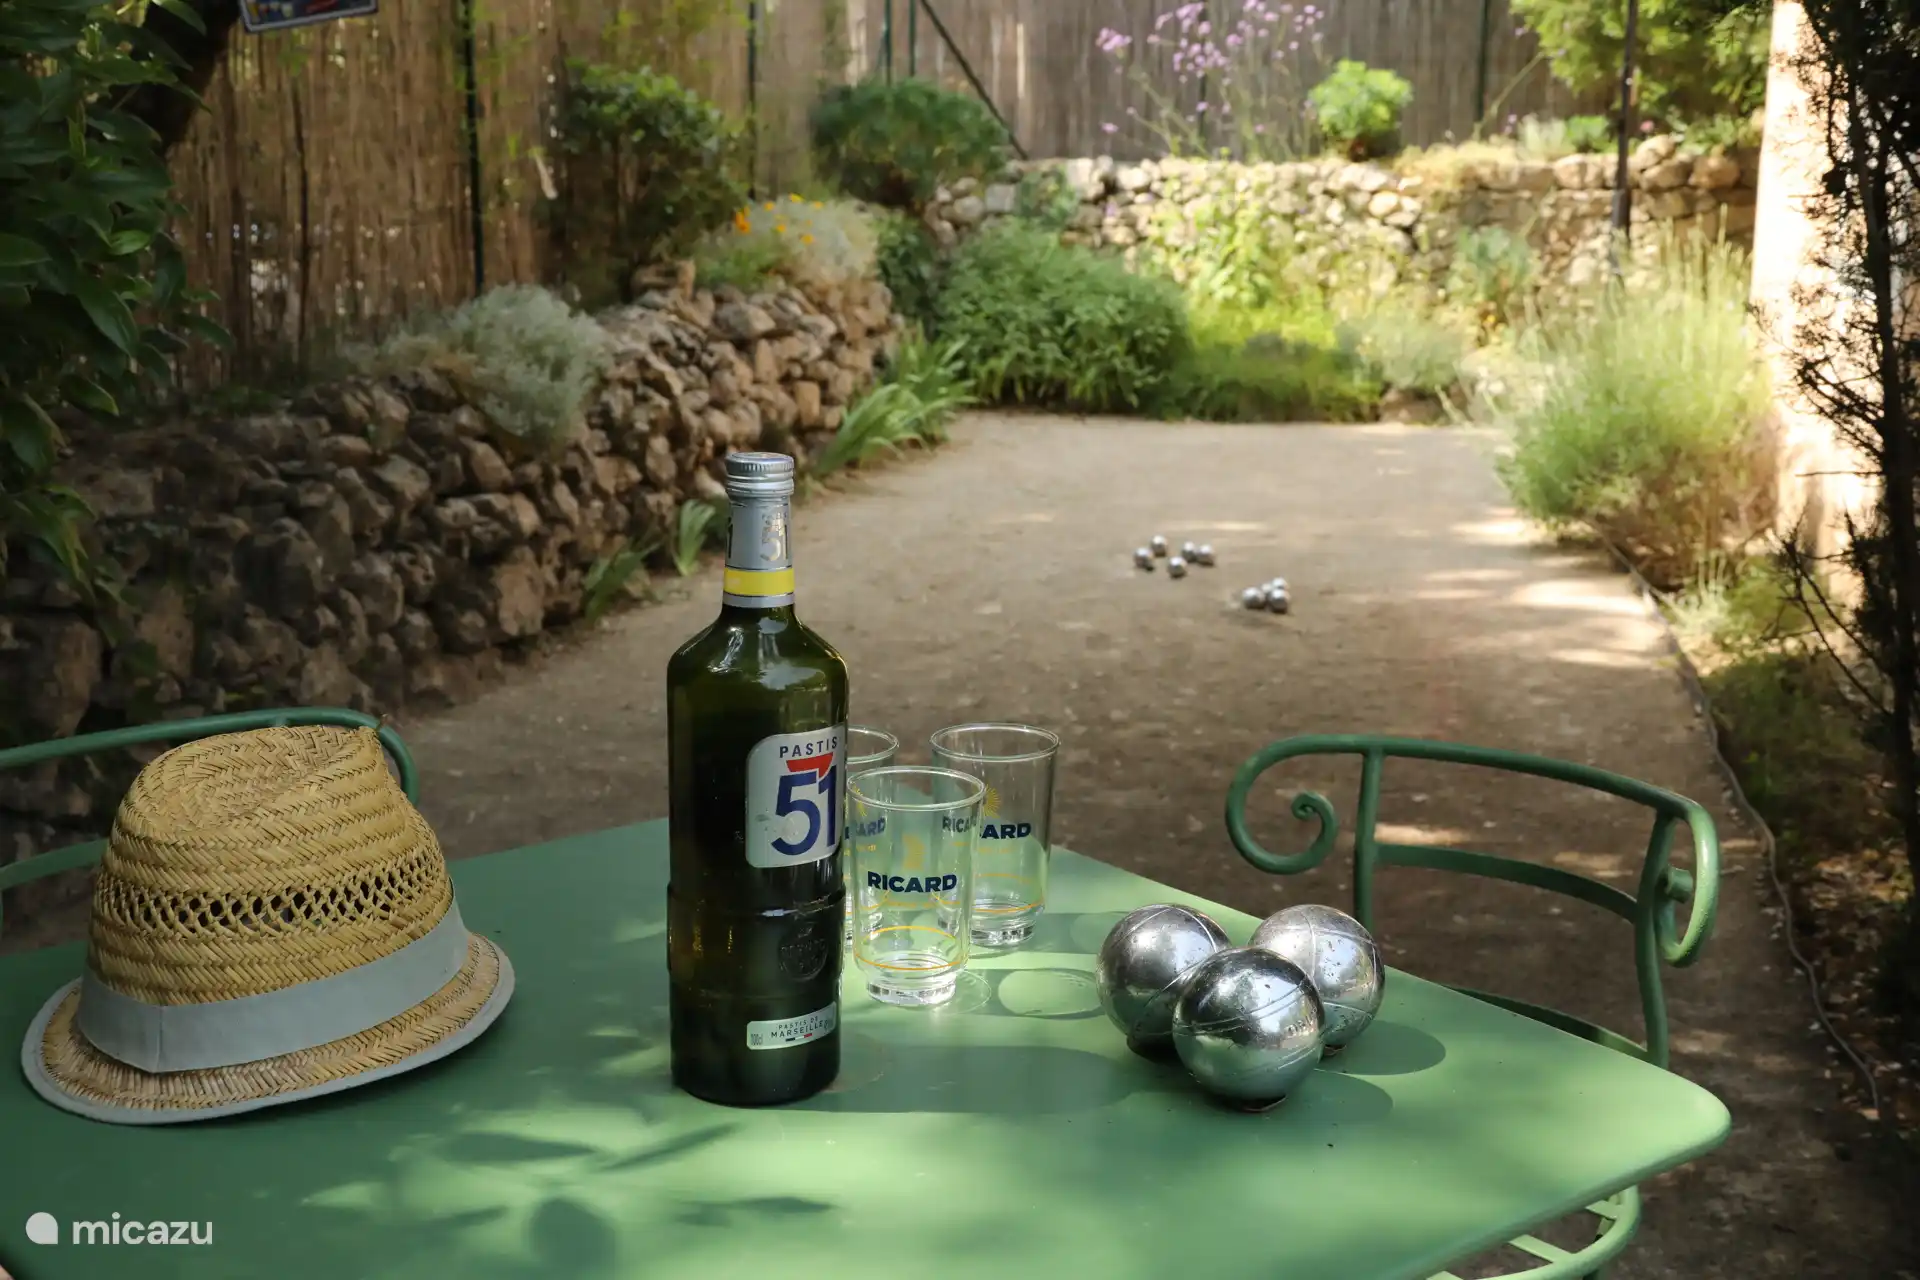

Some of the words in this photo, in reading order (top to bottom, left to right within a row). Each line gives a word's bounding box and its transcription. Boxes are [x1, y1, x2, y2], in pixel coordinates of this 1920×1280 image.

[779, 736, 837, 759] PASTIS
[770, 764, 838, 856] 51
[979, 822, 1032, 840] ARD
[867, 870, 958, 893] RICARD
[770, 1020, 824, 1039] MARSEILLE
[778, 1020, 808, 1030] PASTIS
